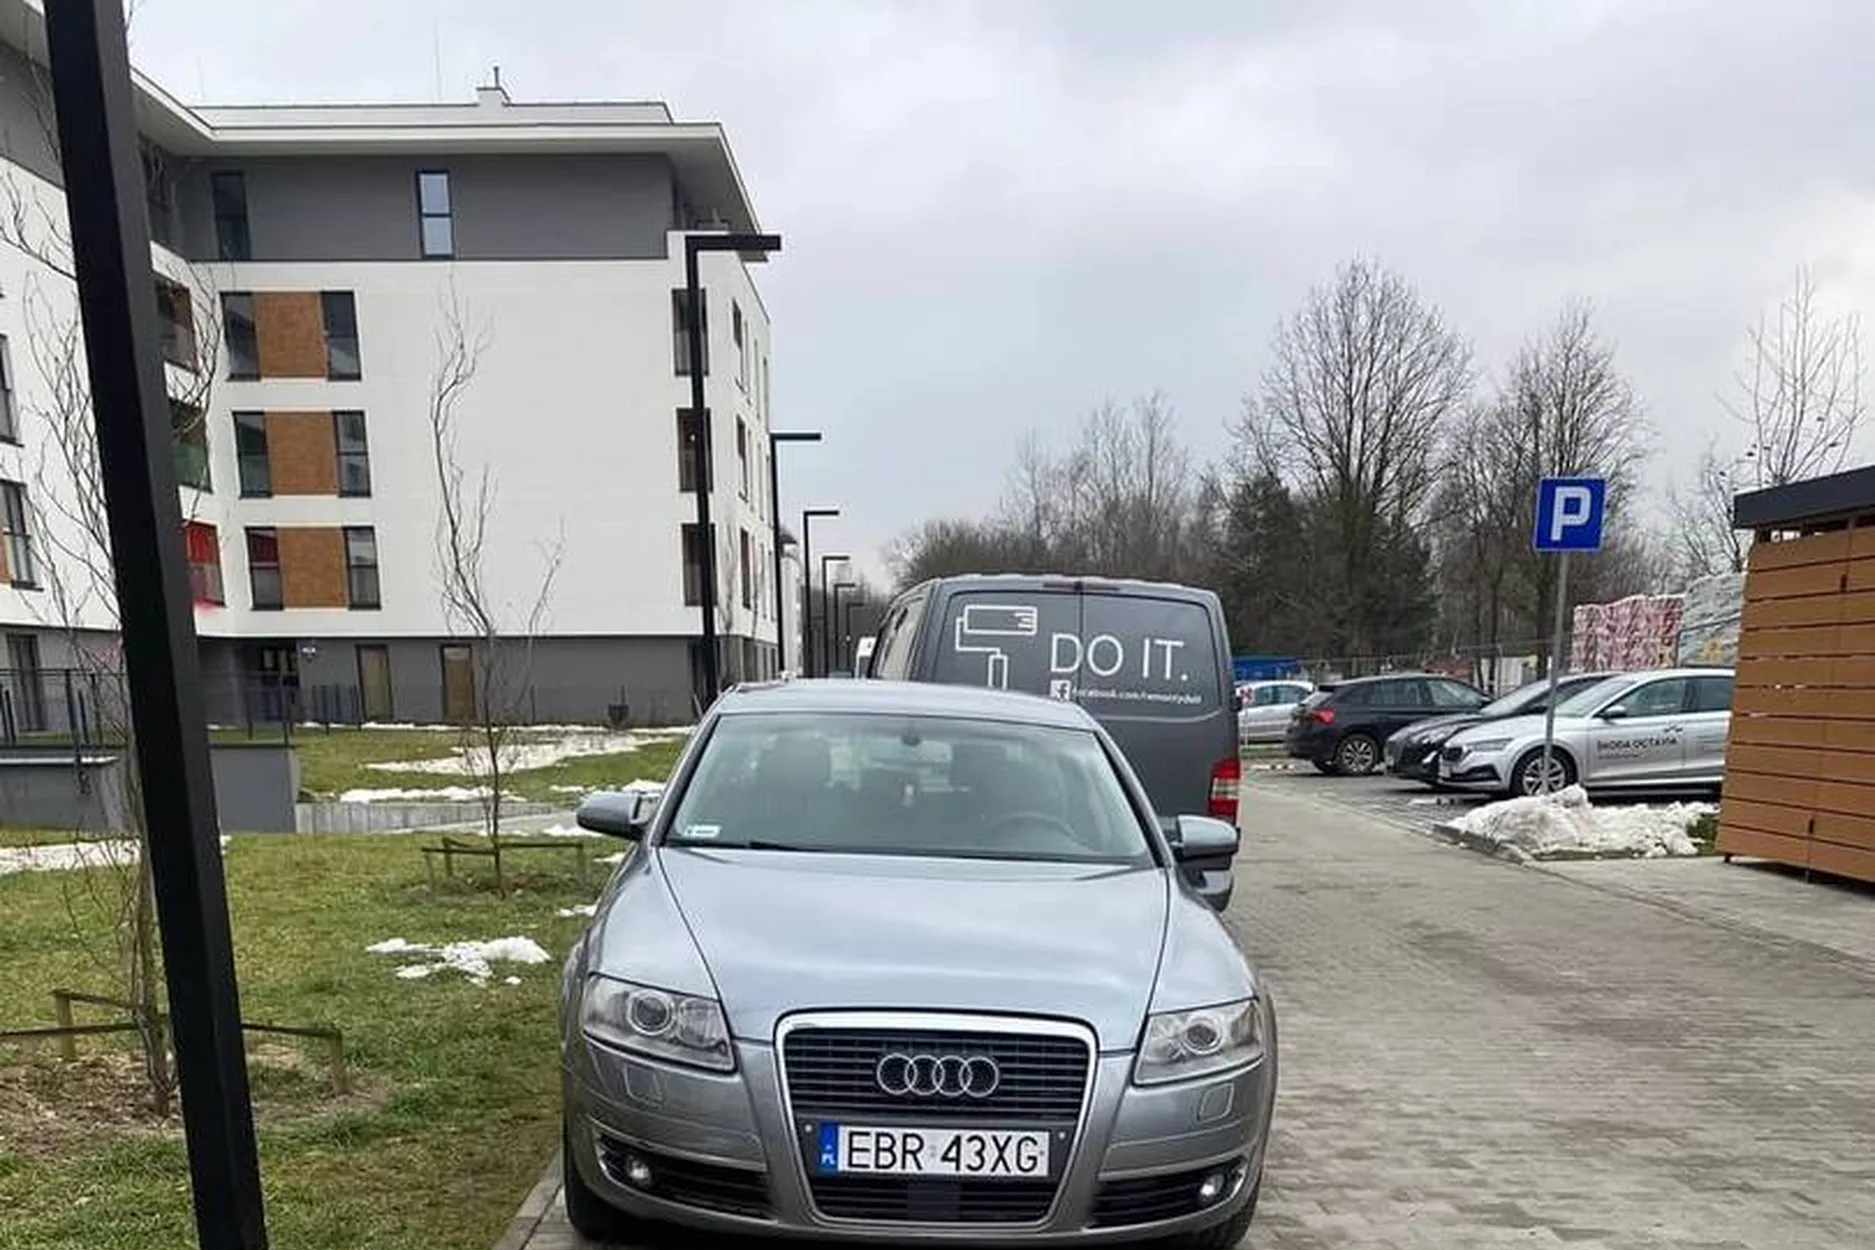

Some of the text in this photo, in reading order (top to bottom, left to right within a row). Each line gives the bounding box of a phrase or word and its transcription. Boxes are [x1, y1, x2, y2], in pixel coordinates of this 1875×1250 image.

[1551, 486, 1591, 541] P
[1050, 633, 1188, 681] DO IT.
[847, 1131, 1038, 1173] EBR 43XG
